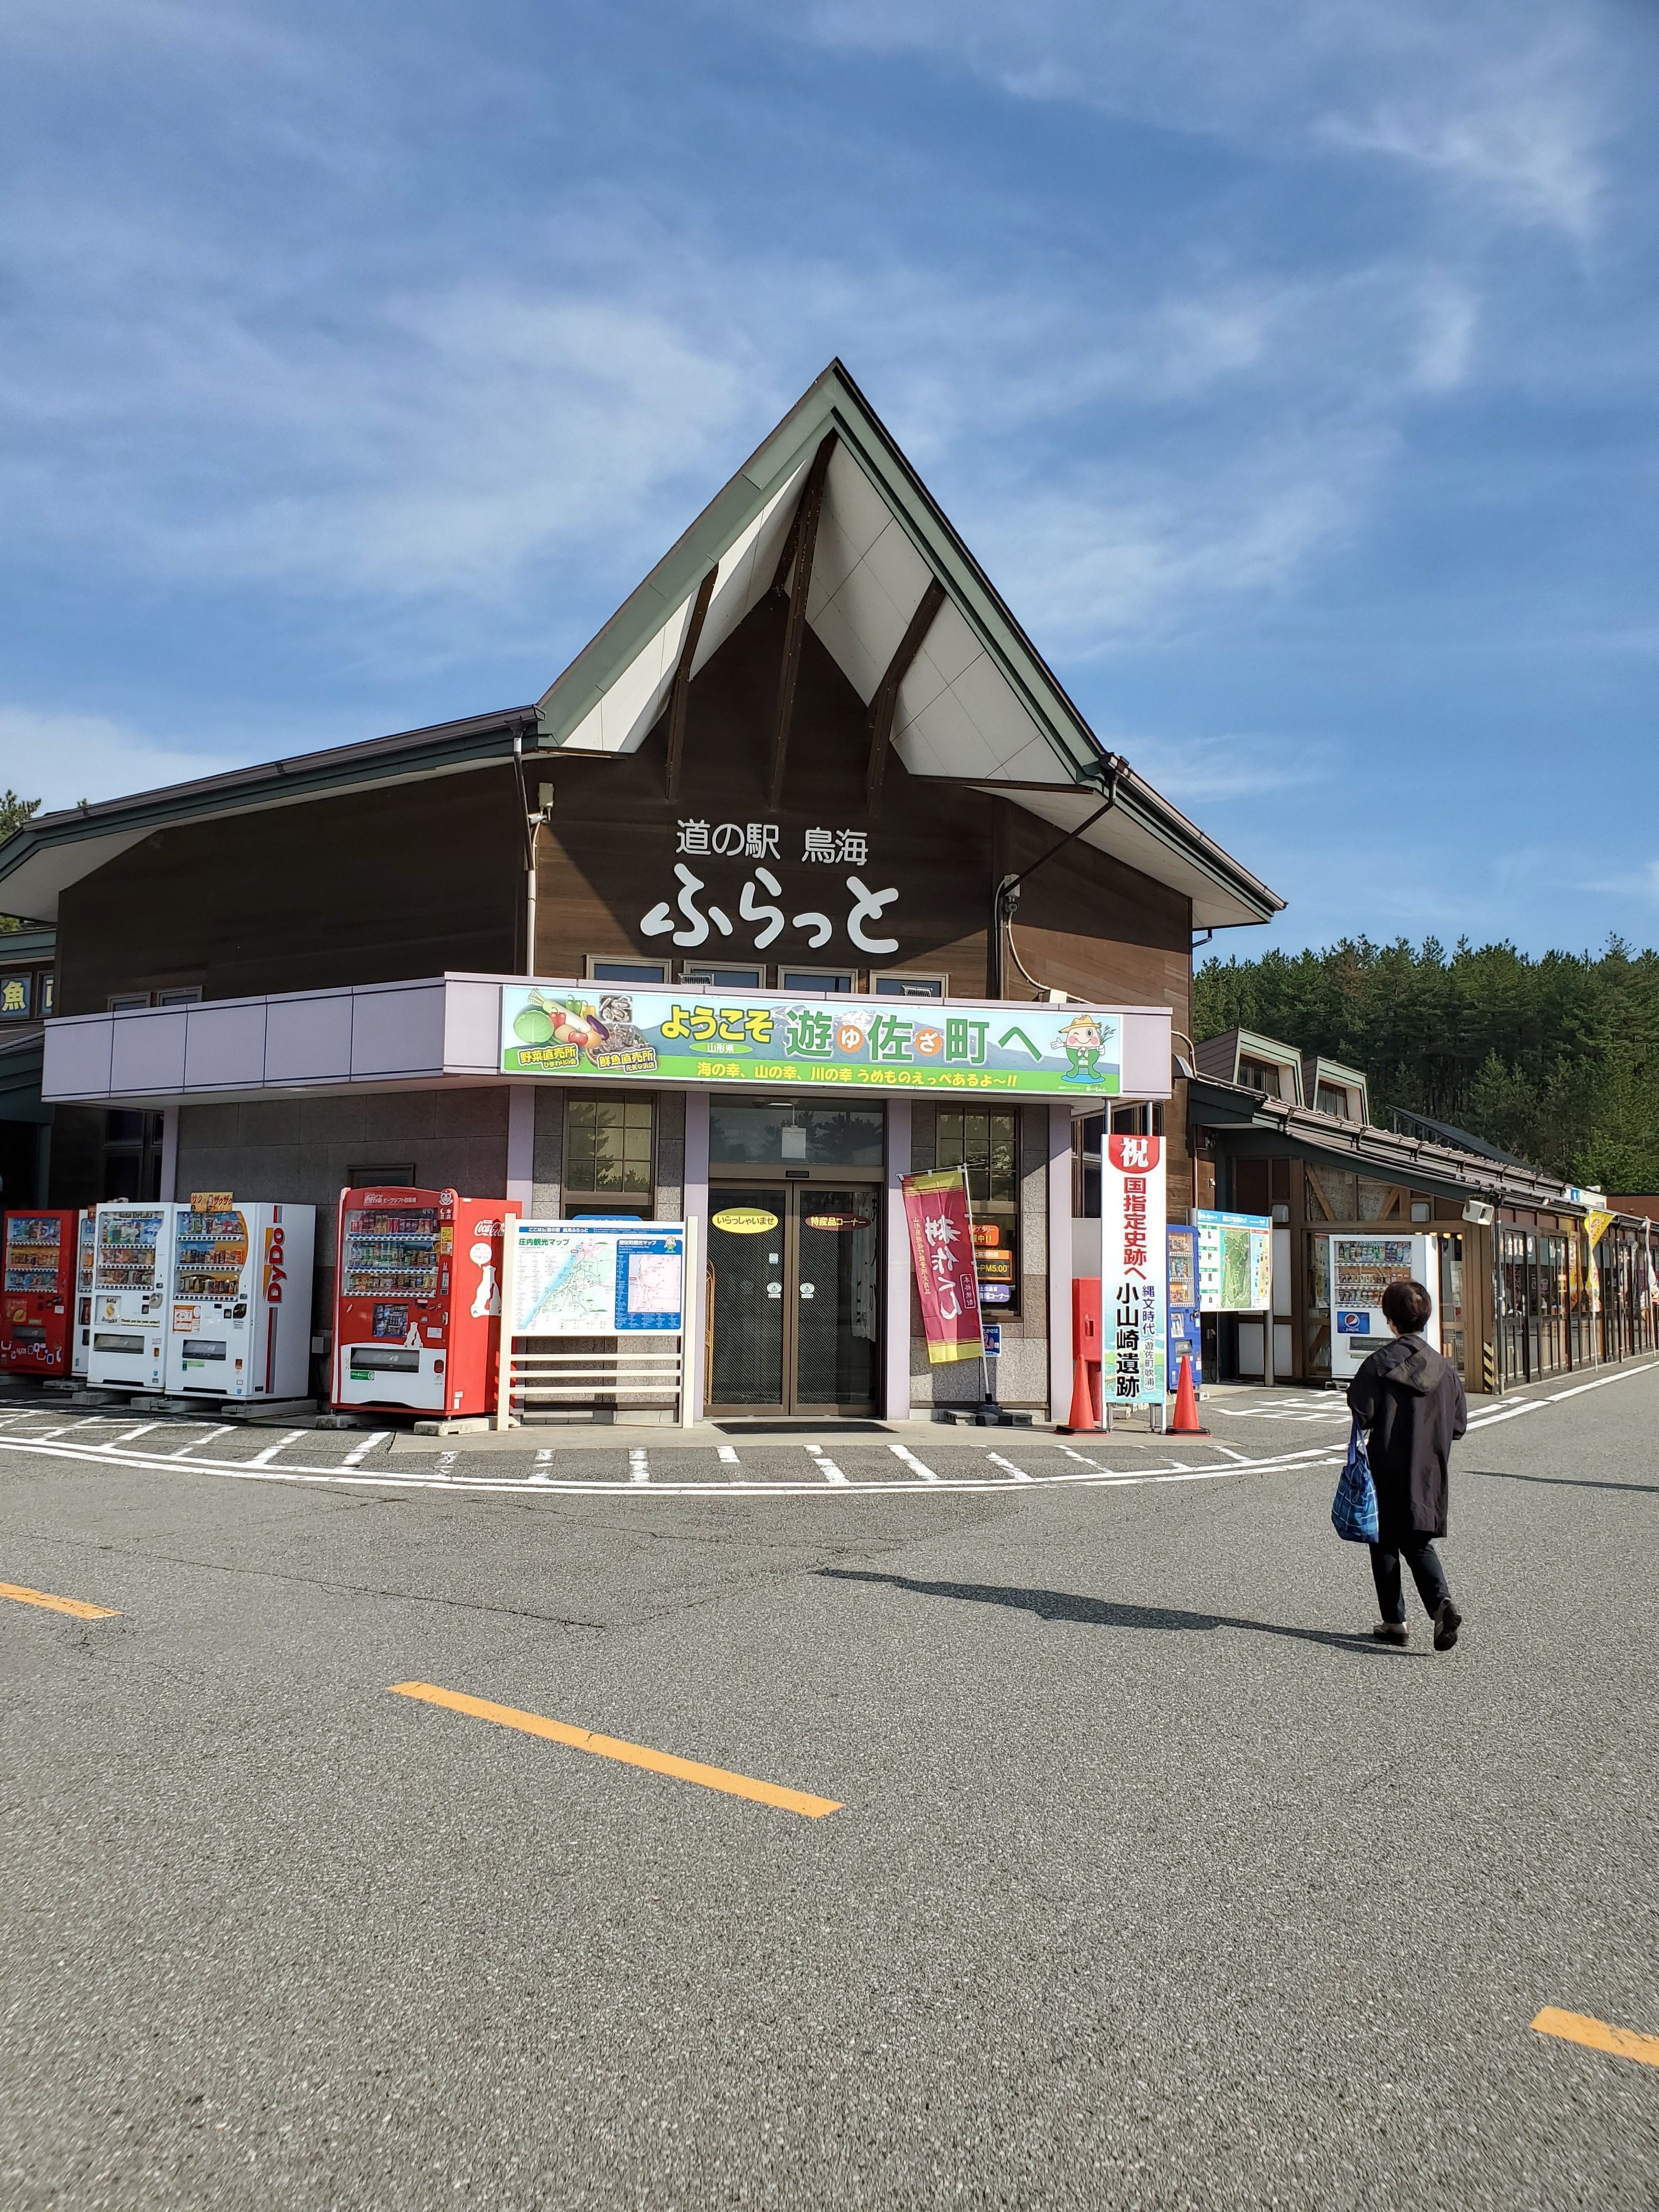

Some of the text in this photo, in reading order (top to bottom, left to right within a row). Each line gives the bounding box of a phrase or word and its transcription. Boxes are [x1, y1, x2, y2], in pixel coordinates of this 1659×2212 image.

[676, 819, 868, 866] 道の駅 鳥海
[640, 863, 899, 953] ふらっと
[661, 1005, 774, 1043] ようこそ
[520, 1046, 577, 1064] 野菜直売所
[599, 1050, 654, 1068] 鮮魚直売所
[707, 1045, 735, 1054] 山形県
[543, 1059, 577, 1068] ひまわりの会
[1119, 1137, 1149, 1167] 祝
[716, 1216, 775, 1225] いらっしゃいませ
[810, 1216, 867, 1227] 特産品コーナー
[1123, 1177, 1147, 1280] 国指定史跡へ
[1116, 1283, 1140, 1398] 小山崎遺跡
